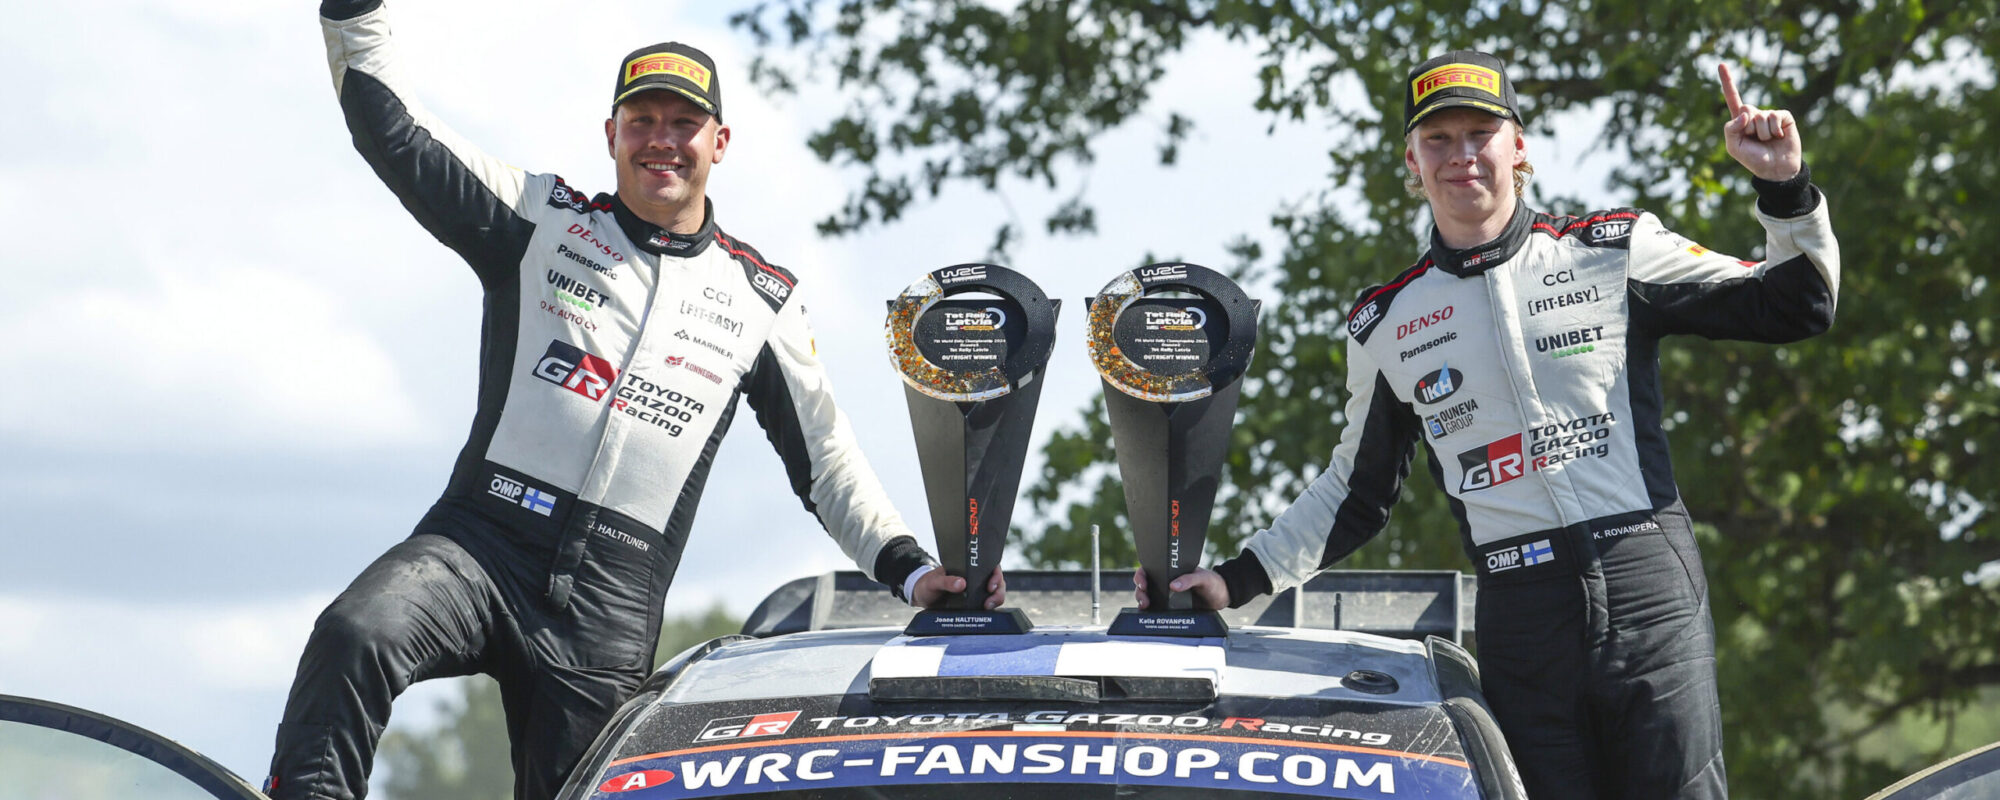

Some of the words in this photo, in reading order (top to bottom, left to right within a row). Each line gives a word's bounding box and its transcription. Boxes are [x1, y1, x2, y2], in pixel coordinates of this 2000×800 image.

[630, 57, 705, 83] PIRELLI
[1417, 67, 1494, 97] PIRELLI
[567, 223, 624, 262] DENSO
[1592, 222, 1630, 239] OMP
[557, 244, 618, 280] Panasonic
[941, 266, 986, 278] WRC
[1141, 265, 1187, 277] WRC
[547, 269, 609, 307] UNIBET
[753, 273, 788, 300] OMP
[557, 309, 583, 325] AUTO
[1350, 304, 1379, 332] OMP
[1396, 305, 1454, 341] DENSO
[1400, 331, 1458, 362] Panasonic
[1535, 326, 1604, 353] UNIBET
[536, 356, 610, 399] GR
[616, 386, 692, 424] GAZOO
[626, 373, 705, 415] TOYOTA
[609, 398, 683, 437] Racing
[1446, 413, 1474, 433] GROUP
[1529, 411, 1616, 440] TOYOTA
[1530, 428, 1610, 457] GAZOO
[1462, 453, 1523, 491] GR
[1532, 443, 1609, 472] Racing
[490, 478, 522, 499] OMP
[587, 521, 596, 530] J.
[598, 524, 650, 551] HALTTUNEN
[1593, 531, 1603, 540] K.
[970, 537, 978, 566] FULL
[1171, 539, 1179, 568] FULL
[1487, 551, 1520, 570] OMP
[700, 719, 790, 740] GR
[810, 713, 1009, 730] TOYOTA
[1024, 710, 1209, 728] GAZOO
[1220, 716, 1393, 746] Racing
[621, 771, 648, 790] A
[680, 743, 1396, 794] WRC-FANSHOP.COM
